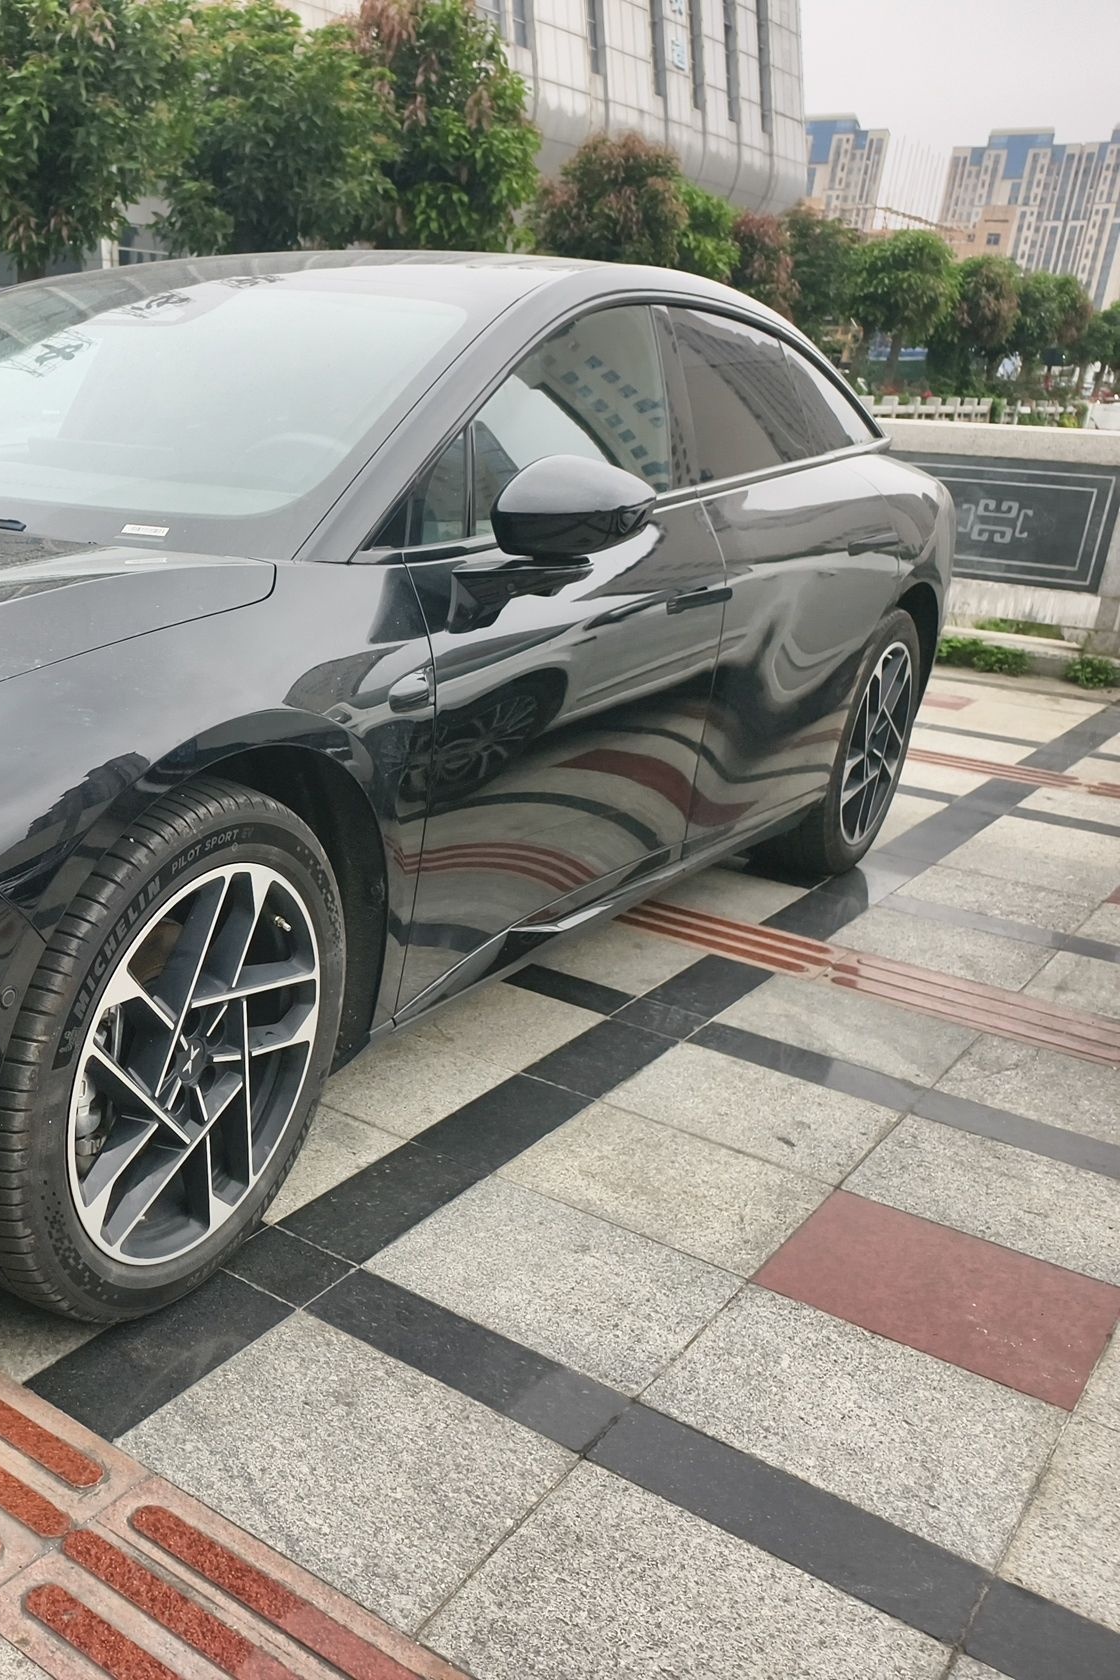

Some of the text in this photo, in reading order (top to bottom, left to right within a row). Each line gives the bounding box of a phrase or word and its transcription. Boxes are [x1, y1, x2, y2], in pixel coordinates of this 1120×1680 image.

[74, 875, 162, 1019] MICHELIN
[171, 844, 202, 875] PILOT
[204, 829, 239, 851] SPORT
